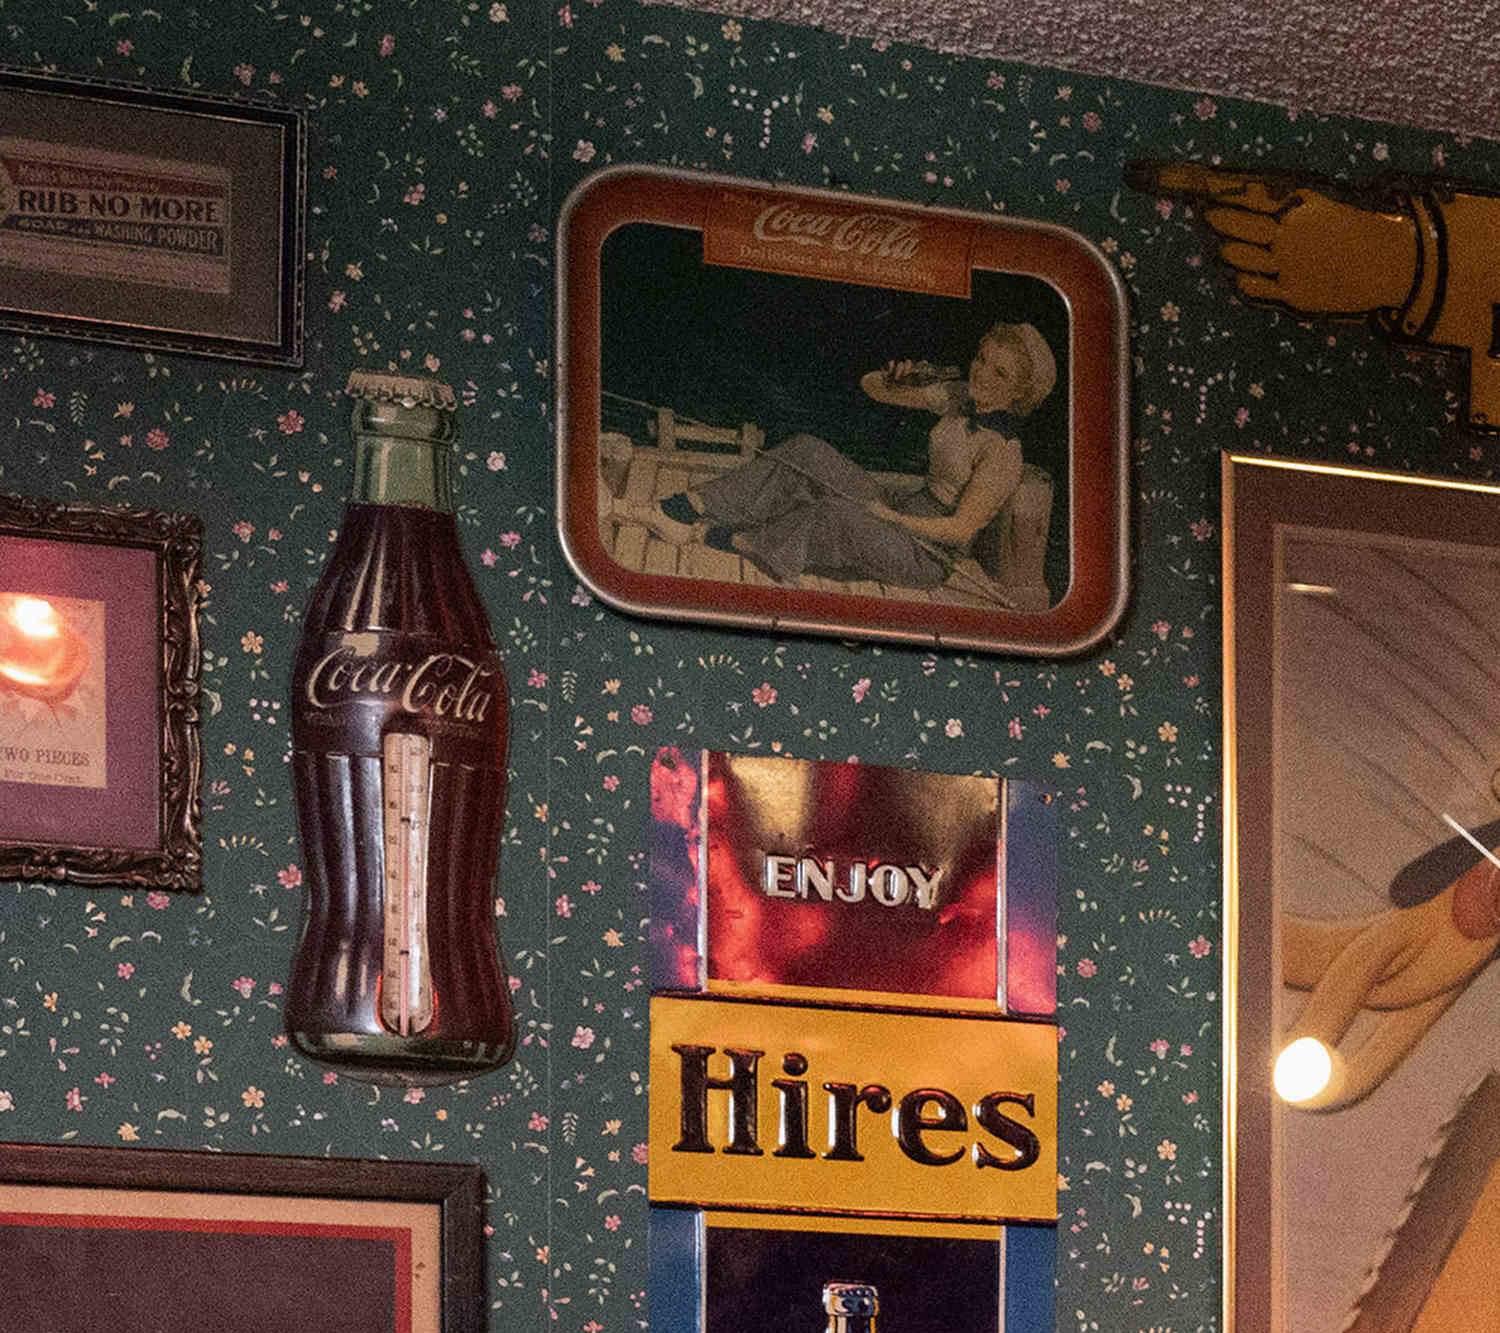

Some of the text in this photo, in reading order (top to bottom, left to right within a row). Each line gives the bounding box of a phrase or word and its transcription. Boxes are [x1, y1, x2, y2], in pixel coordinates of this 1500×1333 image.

[19, 190, 220, 224] RUB NO MORE
[158, 226, 218, 249] POWDER
[35, 748, 90, 767] PIECES
[762, 850, 947, 910] ENJOY
[669, 1041, 1043, 1170] Hires
